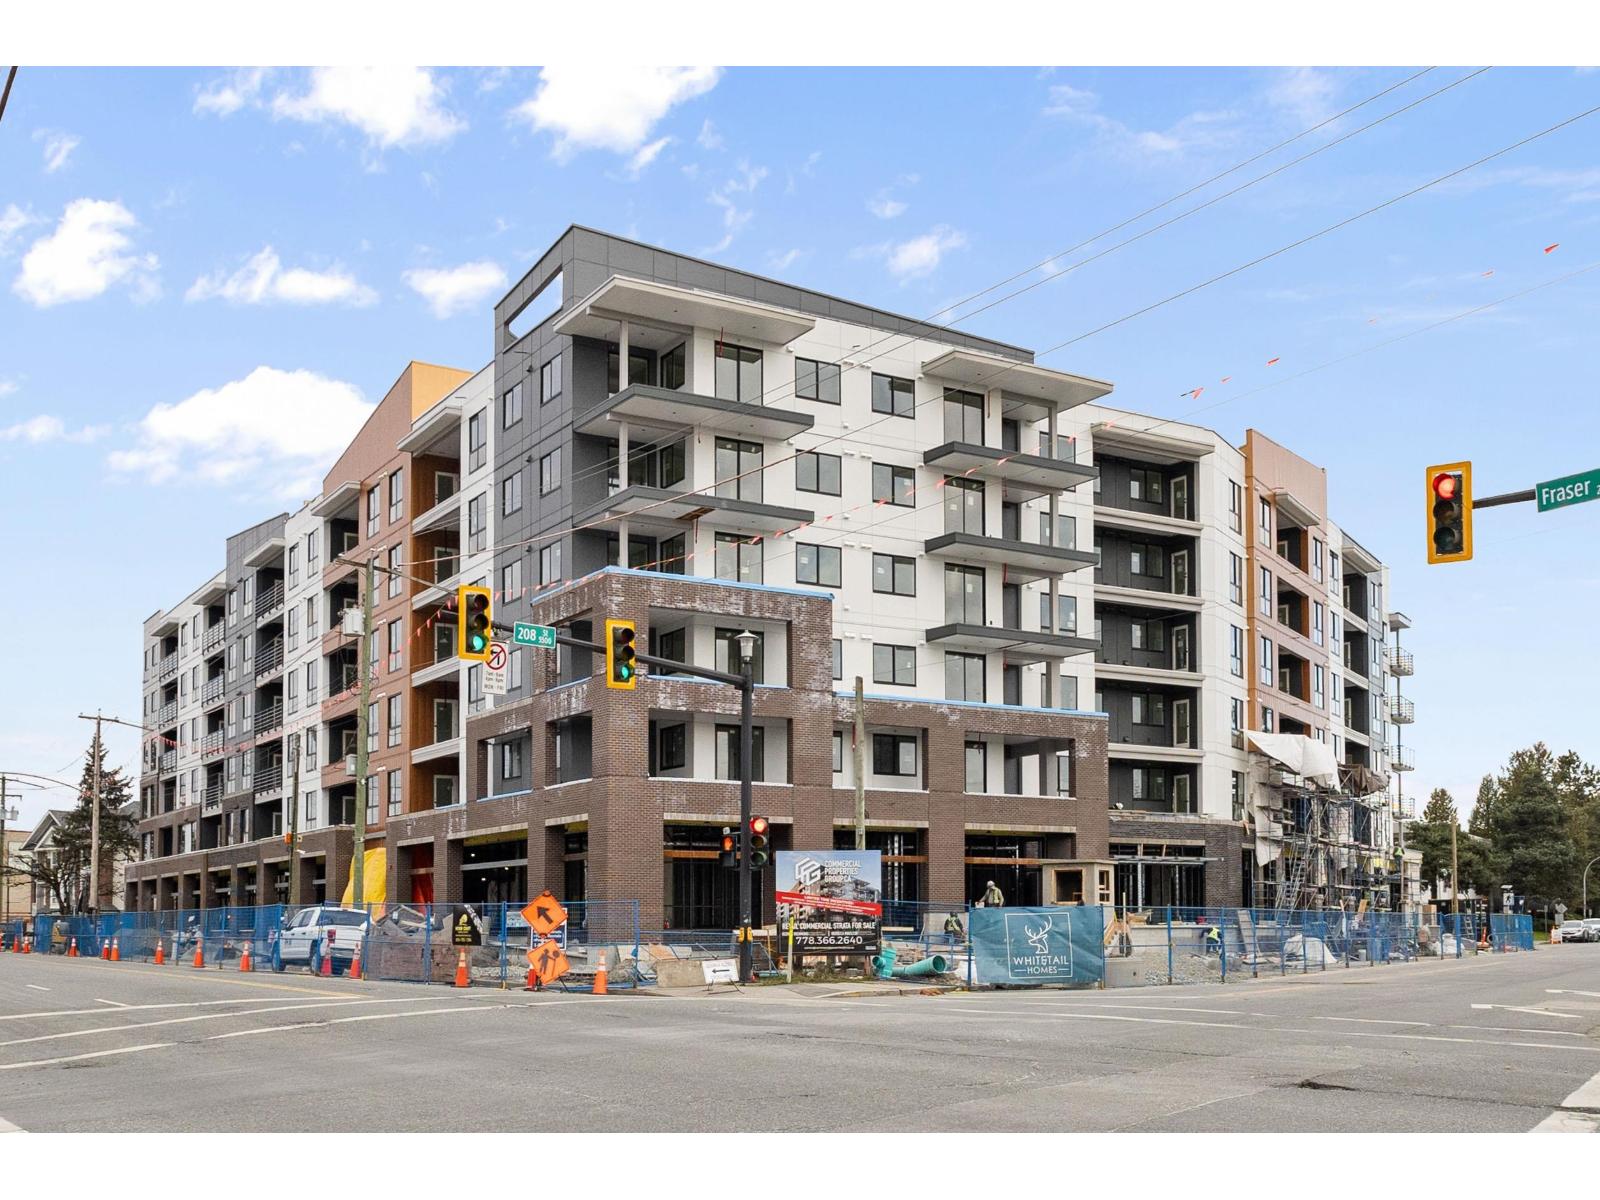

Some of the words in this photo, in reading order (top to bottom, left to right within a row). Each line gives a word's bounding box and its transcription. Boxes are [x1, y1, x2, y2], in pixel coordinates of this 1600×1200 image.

[1541, 480, 1591, 506] Fraser
[517, 627, 537, 641] 208
[824, 860, 862, 868] COMMERCIAL
[824, 867, 859, 875] PROPERTIES
[799, 922, 833, 930] COMMERCIAL
[833, 922, 851, 930] STRATA
[795, 936, 863, 945] 778.366.2640
[1013, 956, 1069, 966] WHITETAIL
[1026, 966, 1058, 975] HOMES
